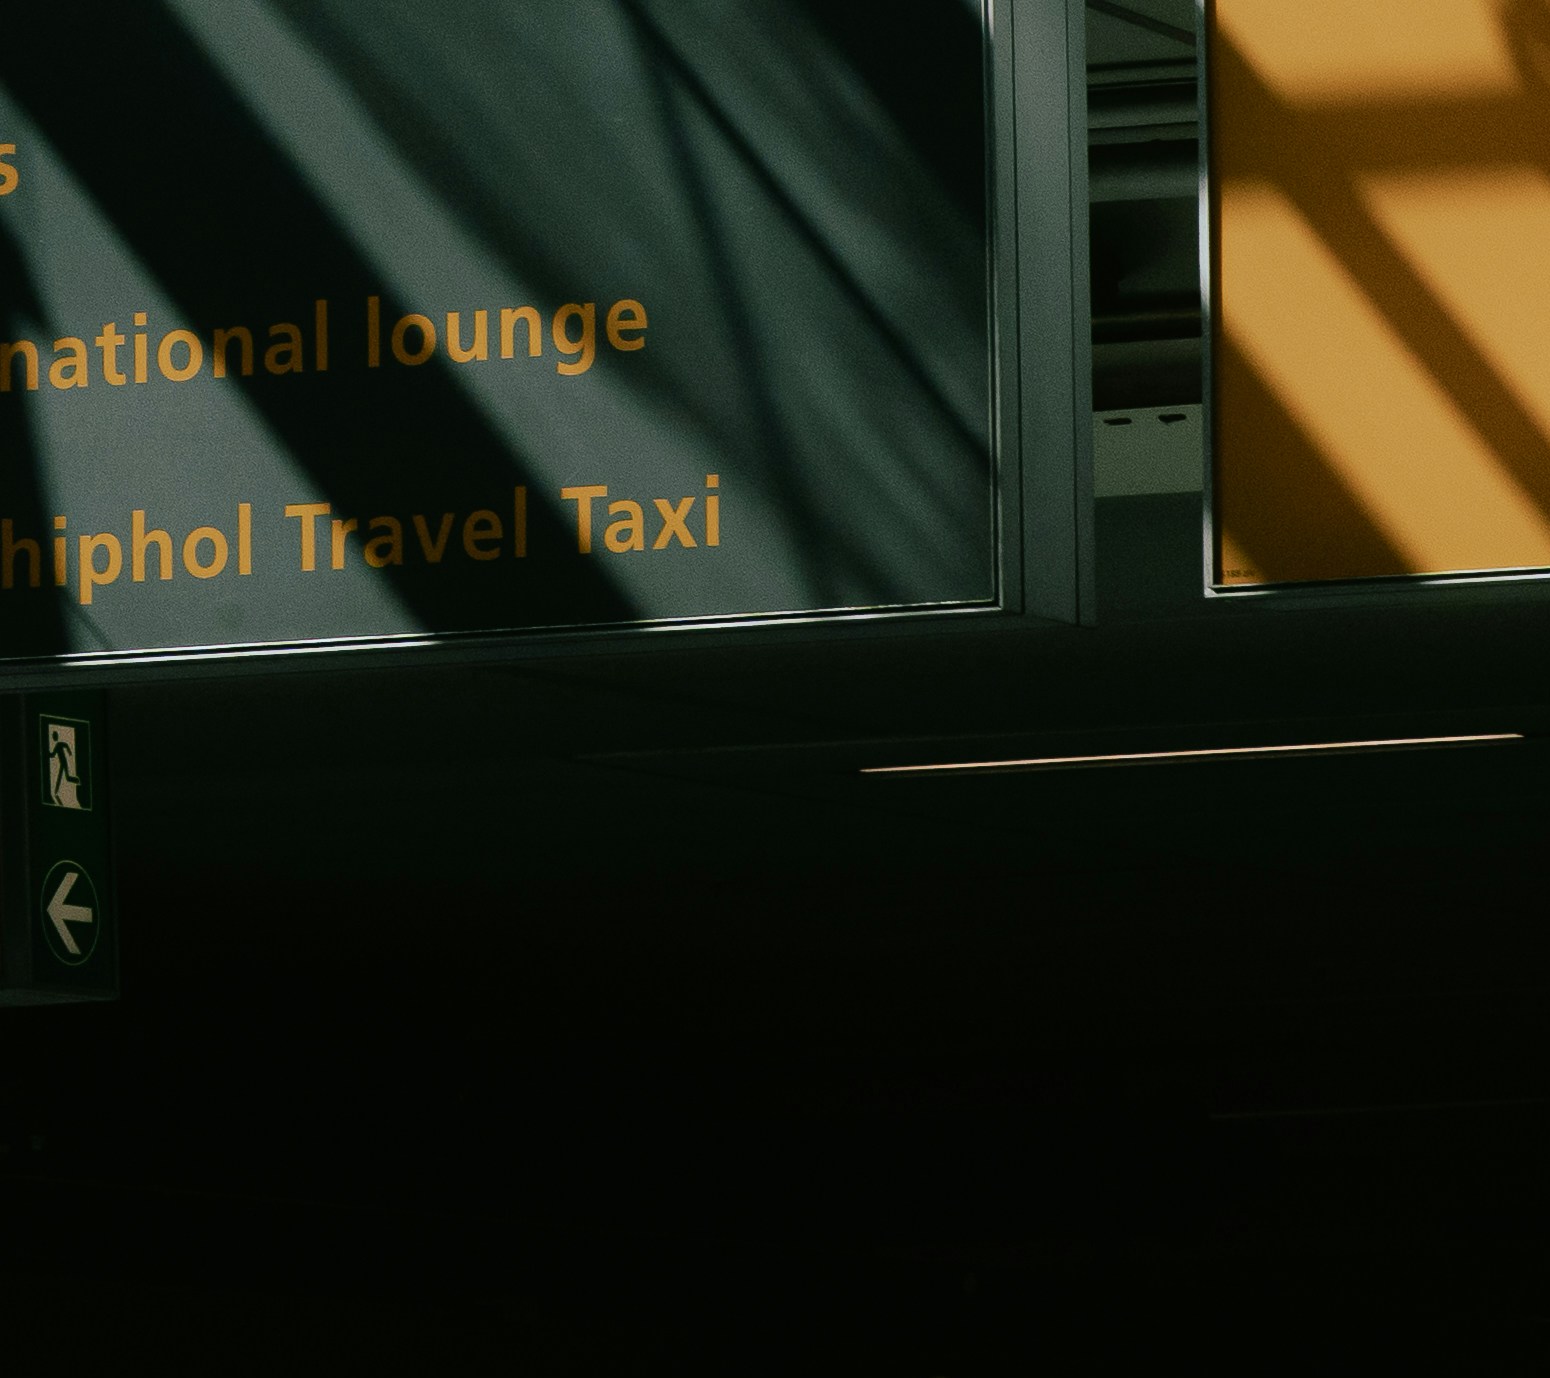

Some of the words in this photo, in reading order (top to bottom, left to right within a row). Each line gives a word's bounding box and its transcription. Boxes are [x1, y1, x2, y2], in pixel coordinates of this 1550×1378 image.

[0, 297, 330, 393] national
[366, 294, 651, 376] lounge
[0, 501, 254, 606] hiphol
[283, 483, 529, 572] Travel
[559, 473, 721, 556] Taxi
